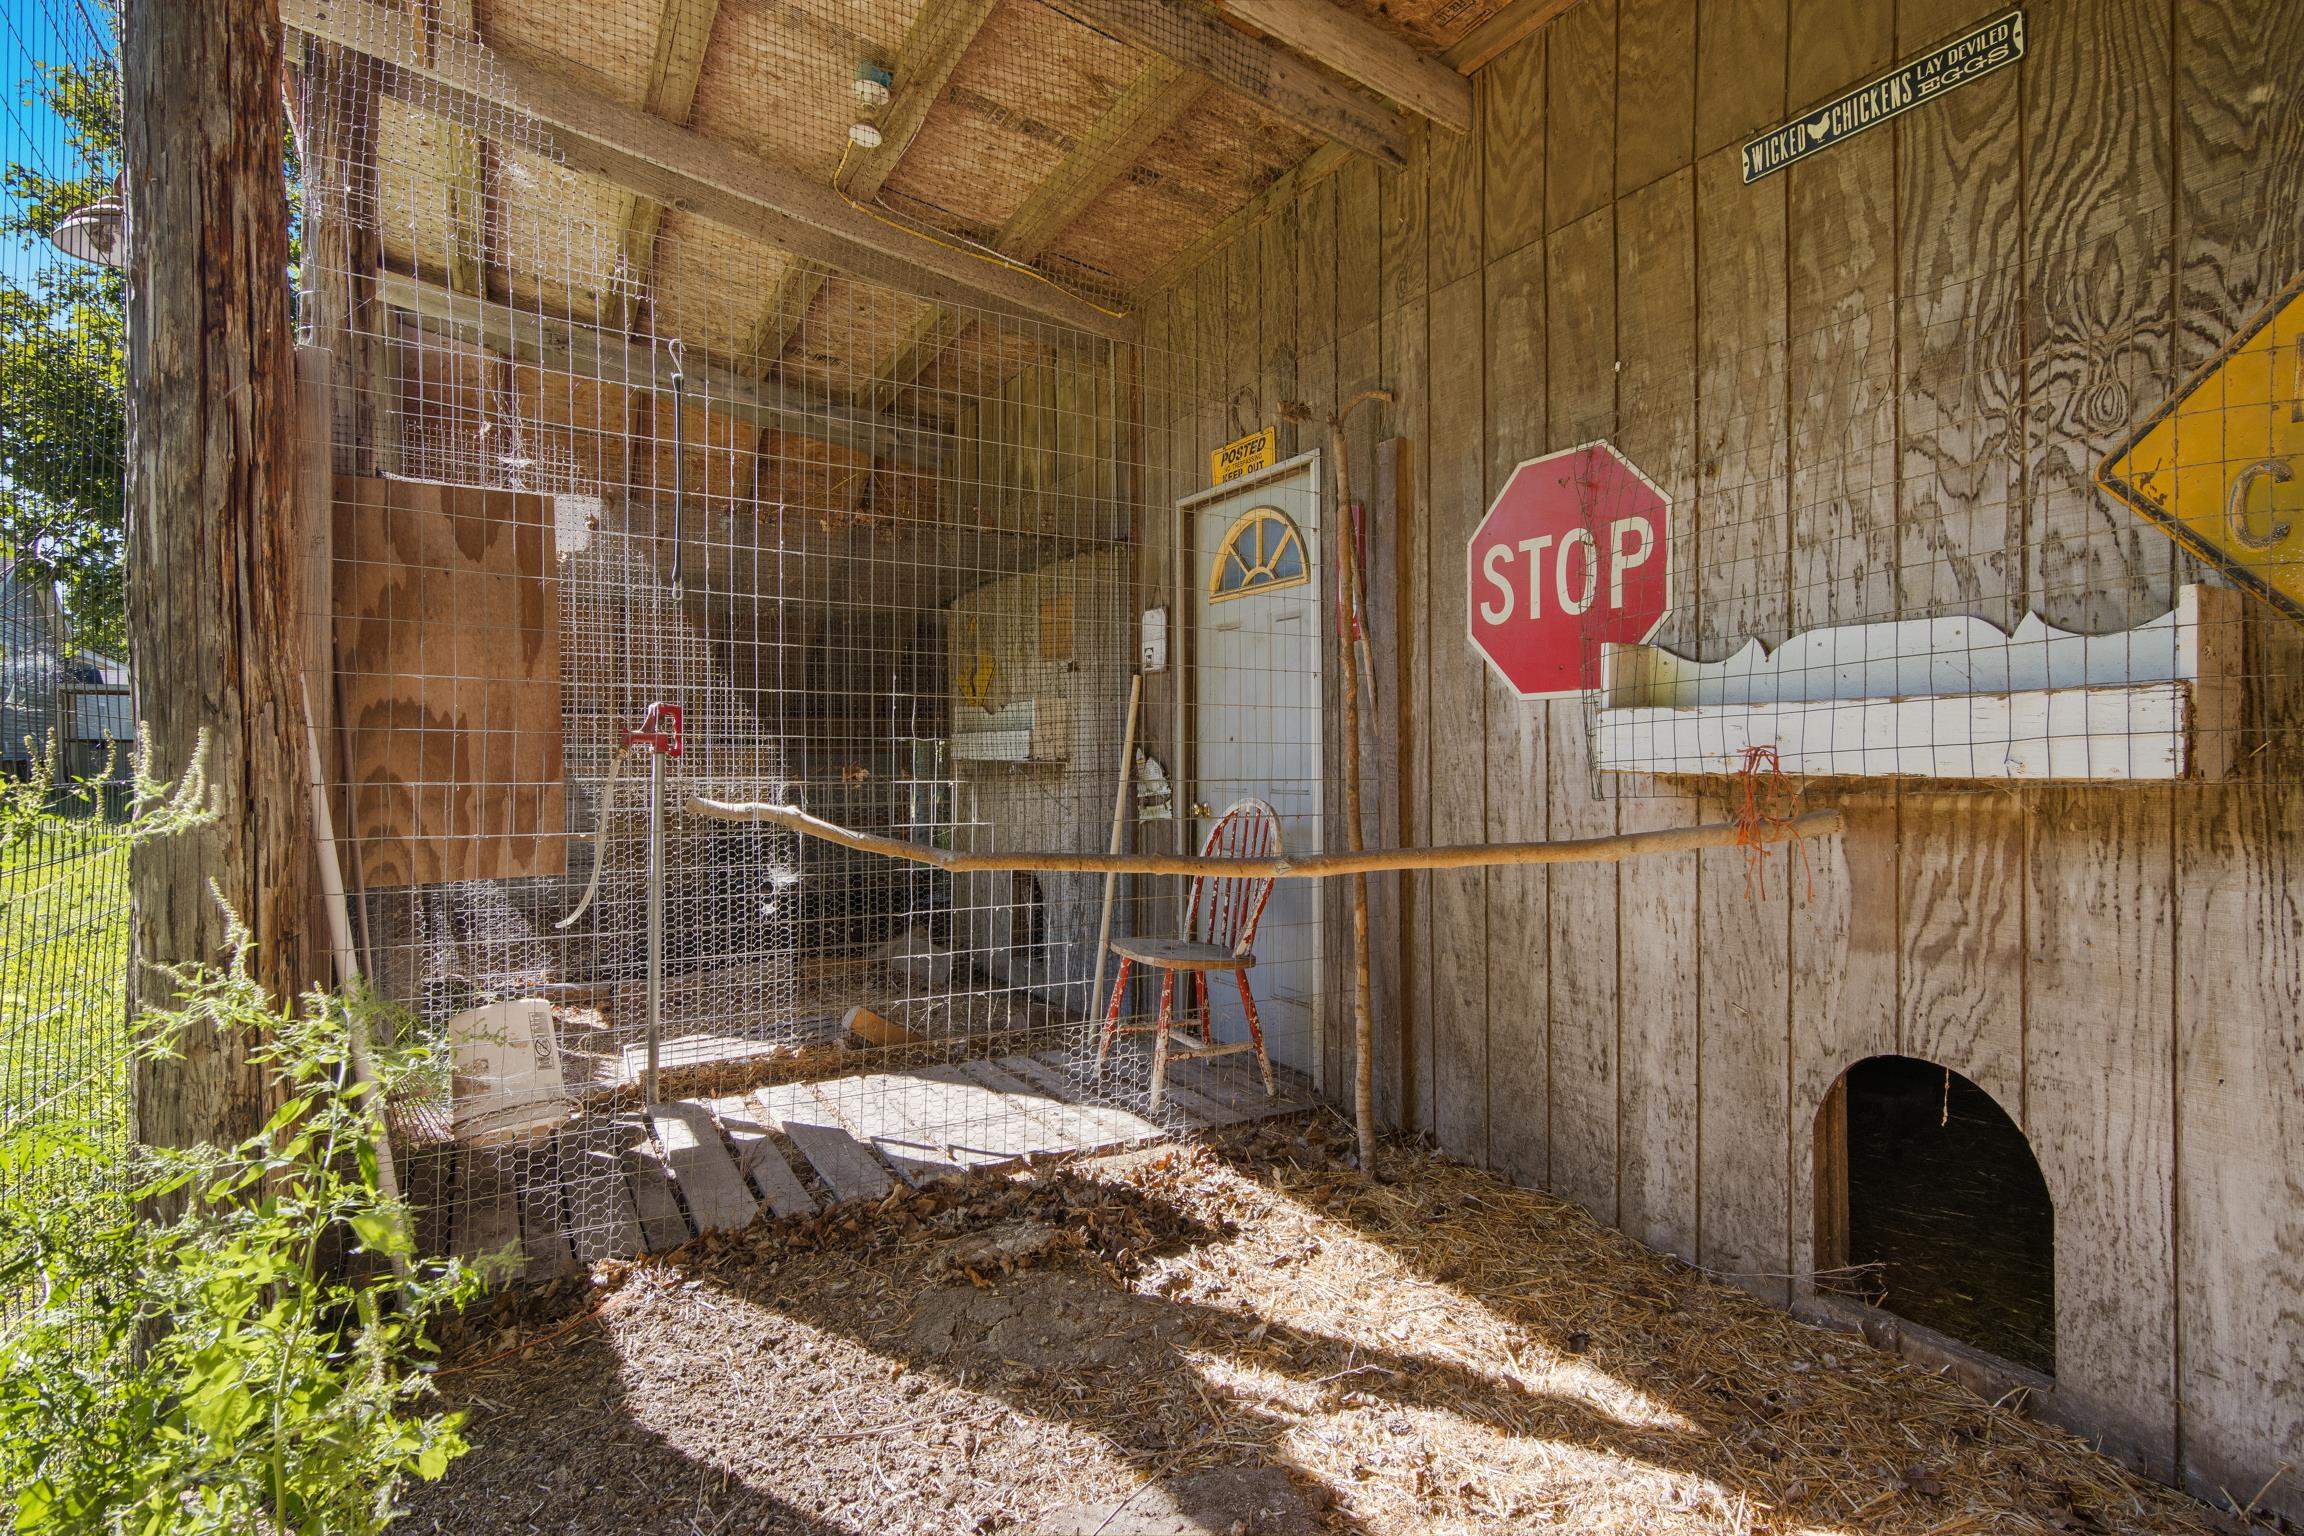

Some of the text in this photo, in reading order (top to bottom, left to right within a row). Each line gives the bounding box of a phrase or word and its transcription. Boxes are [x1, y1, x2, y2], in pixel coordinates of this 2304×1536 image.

[1916, 24, 2009, 80] LAY DEVILED
[1917, 43, 2009, 97] EGGS
[1751, 71, 1913, 174] WICKED CHICKENS
[1220, 436, 1266, 467] POSTED
[1222, 460, 1265, 483] KEEP OUT
[1480, 516, 1654, 626] STOP
